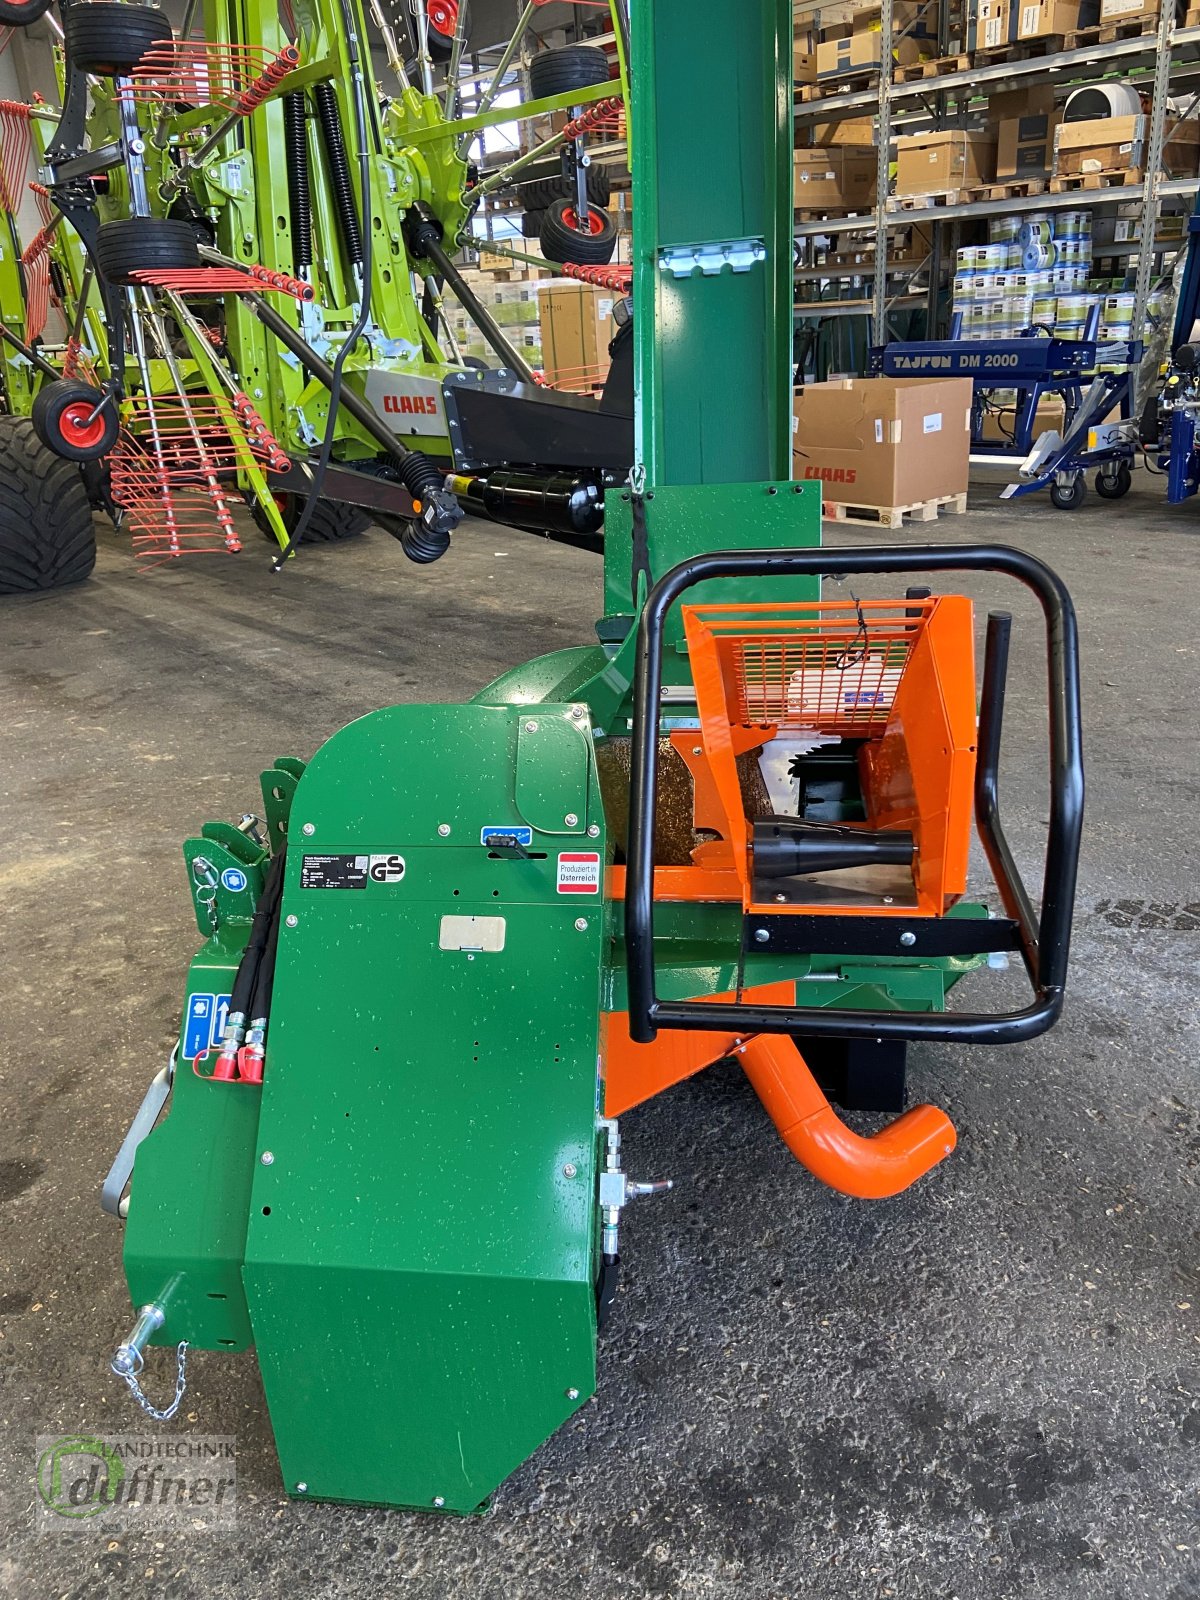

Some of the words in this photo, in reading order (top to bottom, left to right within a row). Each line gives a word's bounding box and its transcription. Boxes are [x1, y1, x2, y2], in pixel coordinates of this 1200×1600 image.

[893, 356, 951, 369] TAJFUN
[959, 355, 980, 368] DM
[984, 354, 1018, 367] 2000
[383, 395, 437, 414] CLAAS
[804, 466, 856, 484] CLAAS
